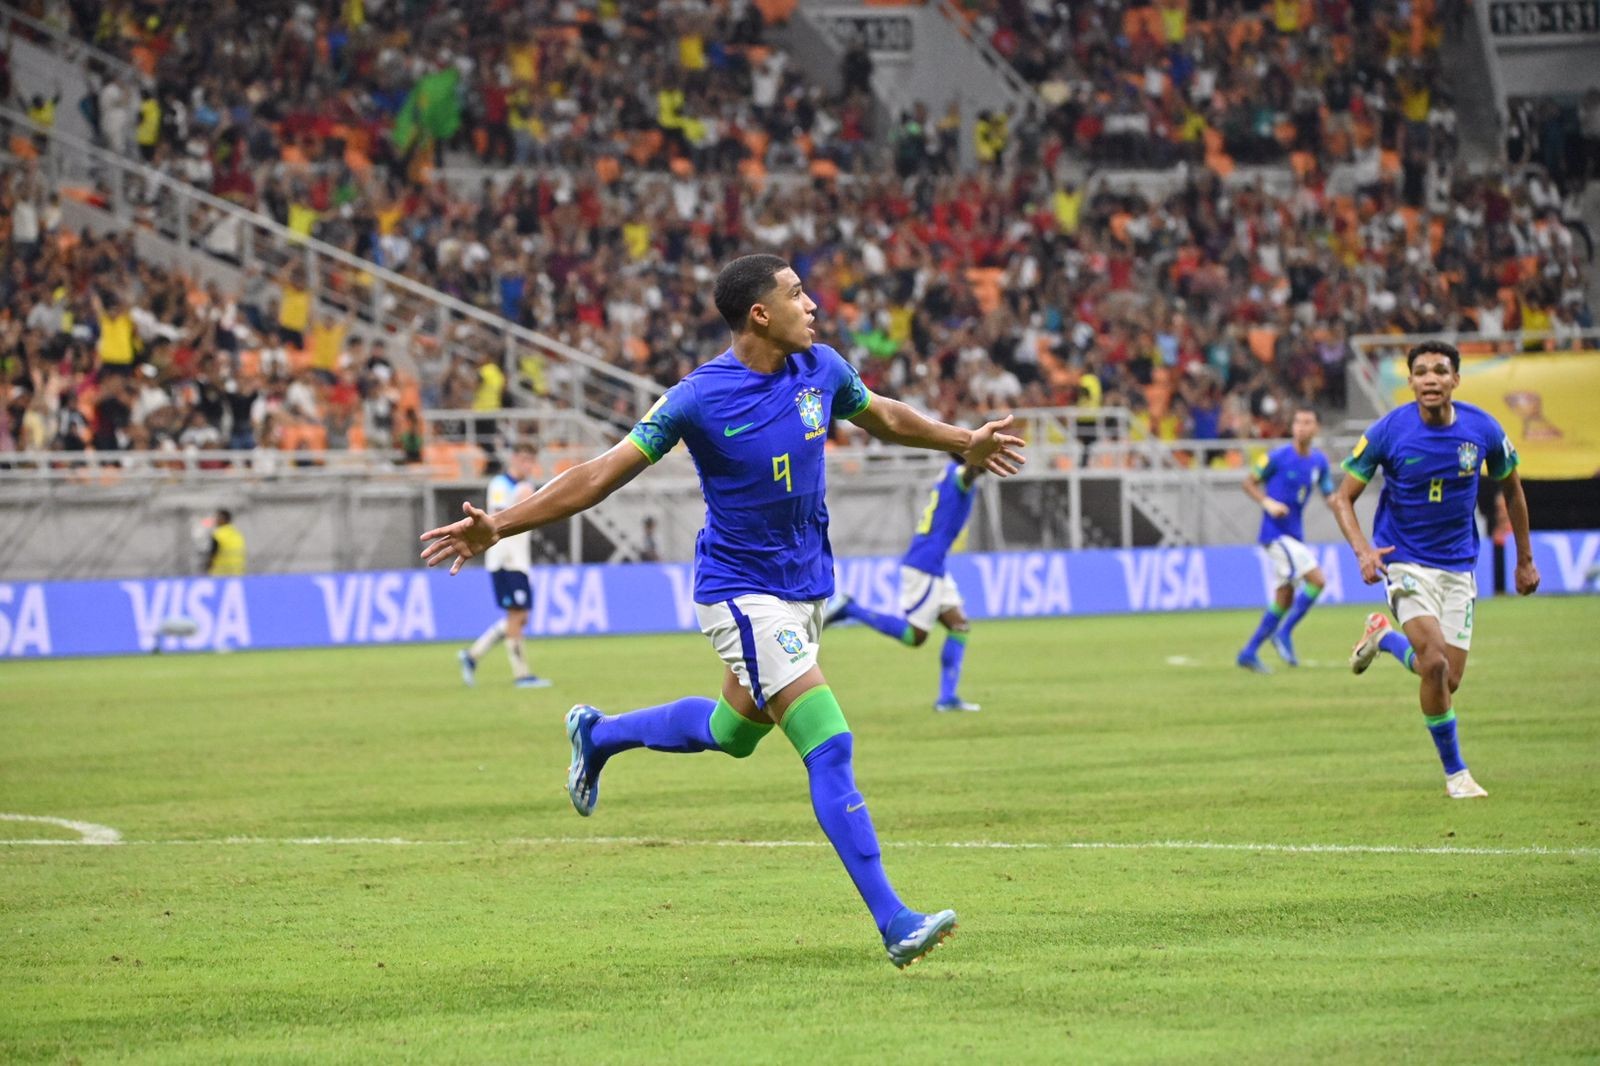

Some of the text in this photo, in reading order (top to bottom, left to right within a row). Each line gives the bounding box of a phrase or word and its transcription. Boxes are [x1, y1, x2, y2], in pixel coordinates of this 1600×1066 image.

[804, 426, 827, 441] BRASIL
[771, 452, 792, 493] 9
[1428, 477, 1444, 503] 8
[311, 572, 437, 643] VISA
[529, 566, 610, 635] ISA
[833, 558, 905, 619] VIS
[972, 552, 1073, 617] VISA
[1114, 548, 1212, 611] VISA
[119, 577, 252, 651] VISA
